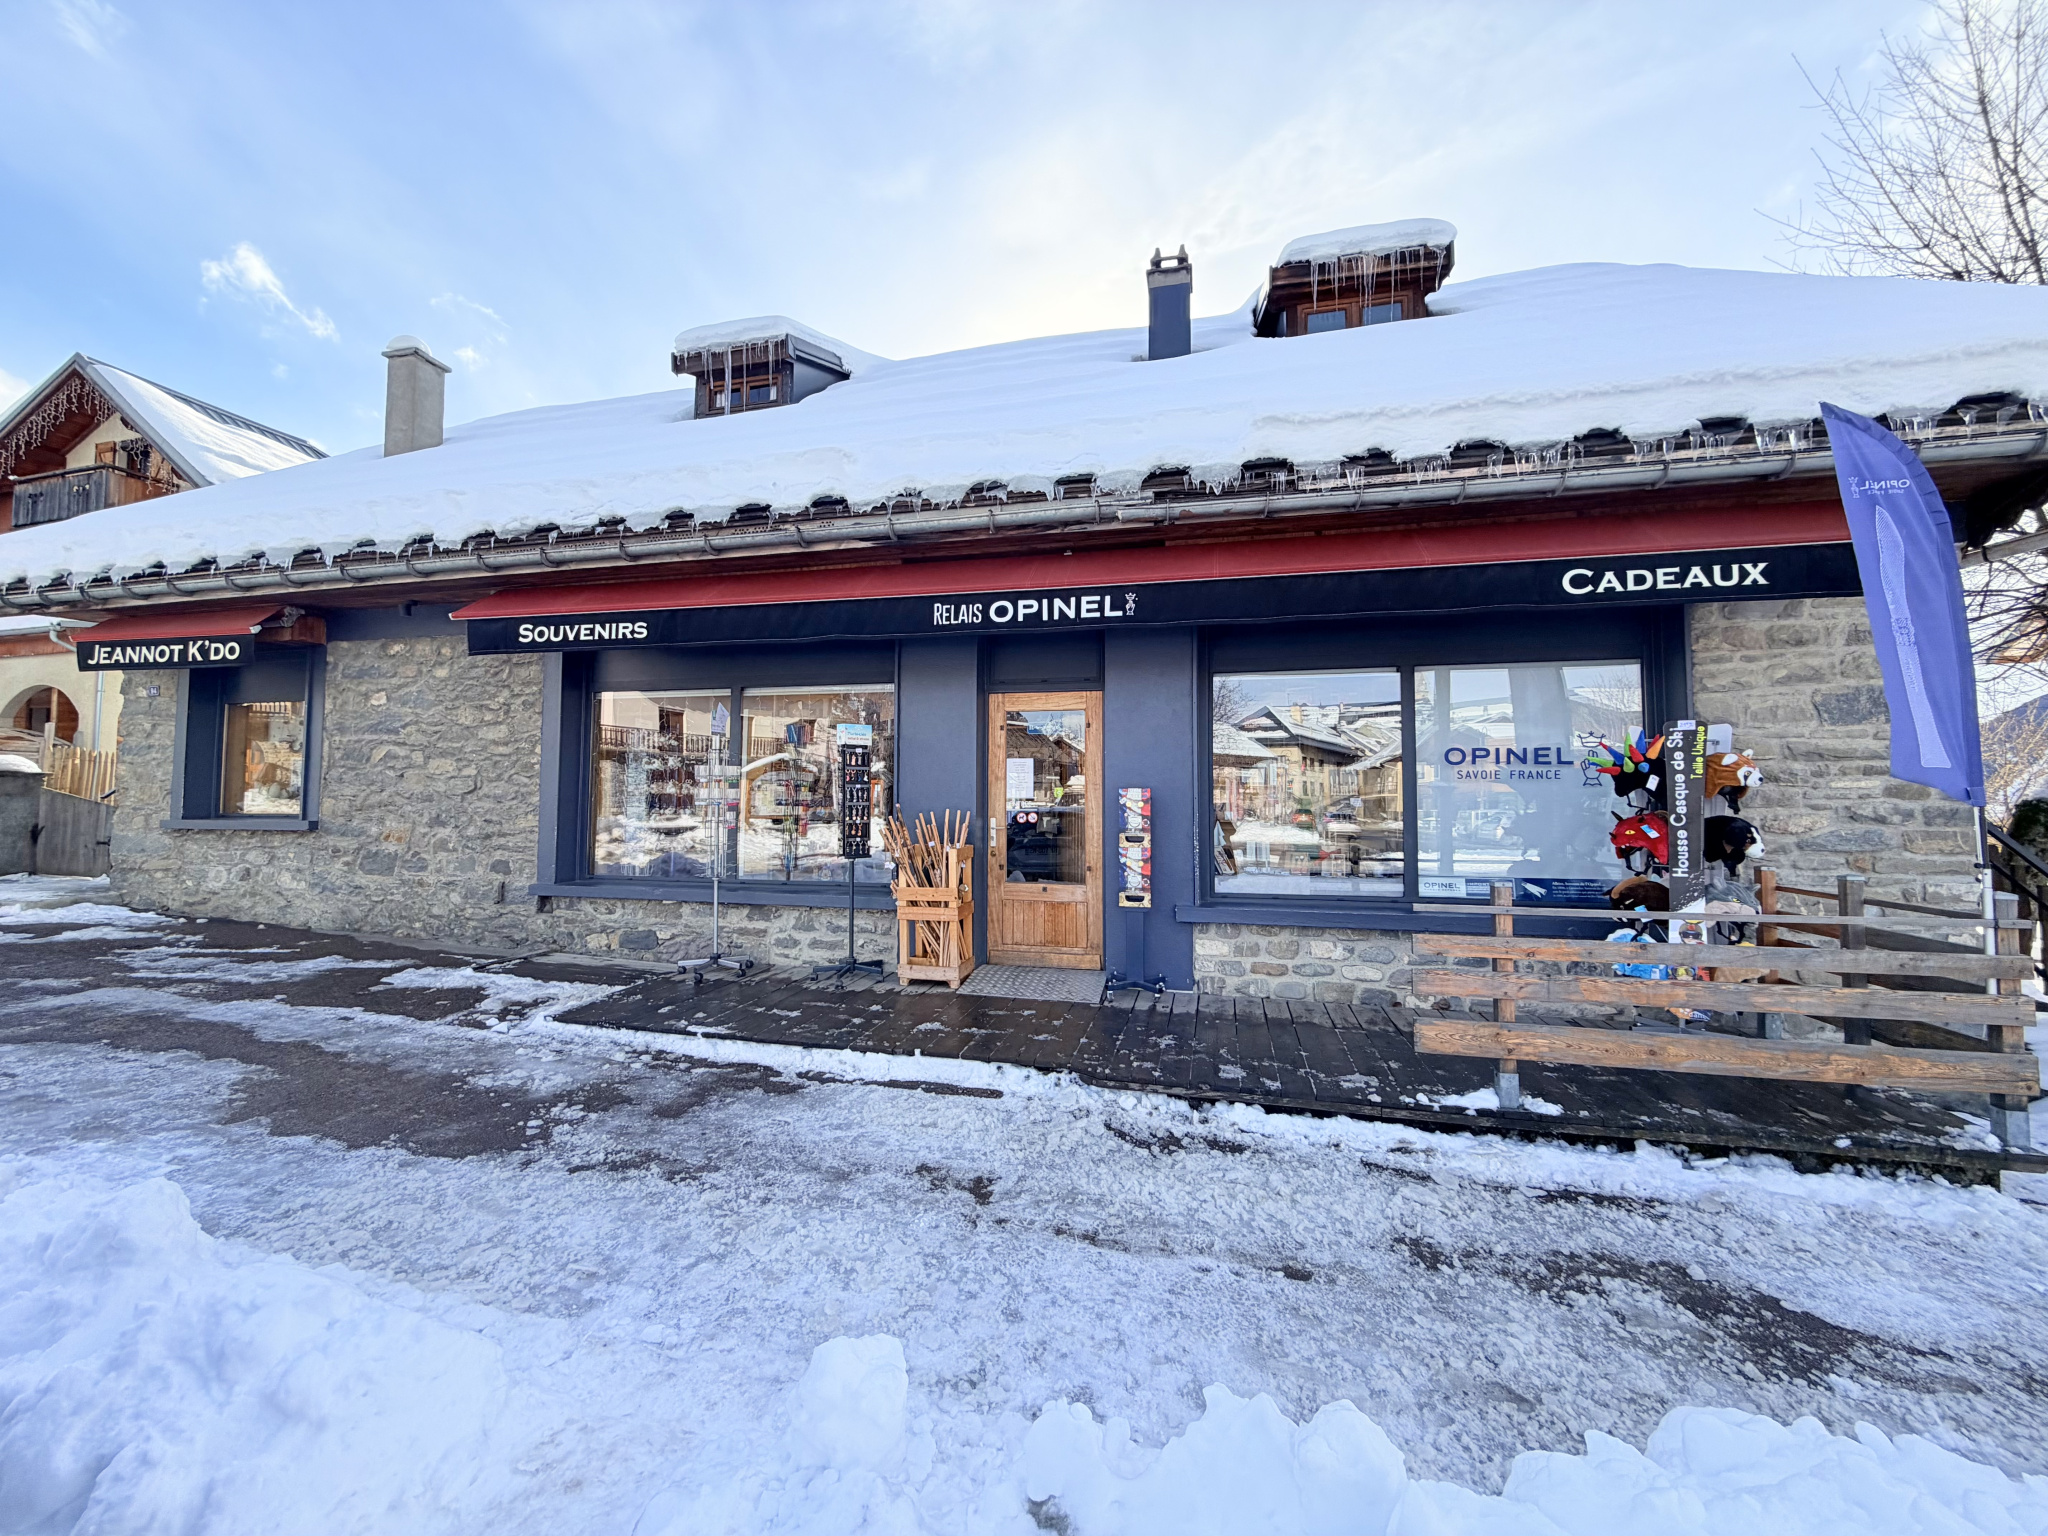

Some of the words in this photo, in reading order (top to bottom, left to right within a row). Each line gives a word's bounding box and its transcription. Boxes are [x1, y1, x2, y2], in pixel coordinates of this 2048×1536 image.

[1562, 563, 1769, 595] CADEAUX
[934, 603, 982, 625] RELAIS
[989, 595, 1123, 623] OPINEL
[518, 622, 648, 643] SOUVENIRS
[87, 644, 184, 665] JEANNOT
[188, 640, 240, 661] K'DO
[1690, 725, 1707, 755] Unique
[1444, 747, 1574, 766] OPINEL
[1670, 751, 1685, 770] de
[1456, 769, 1501, 780] SAVOIE
[1510, 769, 1561, 780] FRANCE
[1670, 773, 1689, 827] Casque
[1672, 829, 1689, 877] Housse
[1423, 881, 1461, 889] OPINEL
